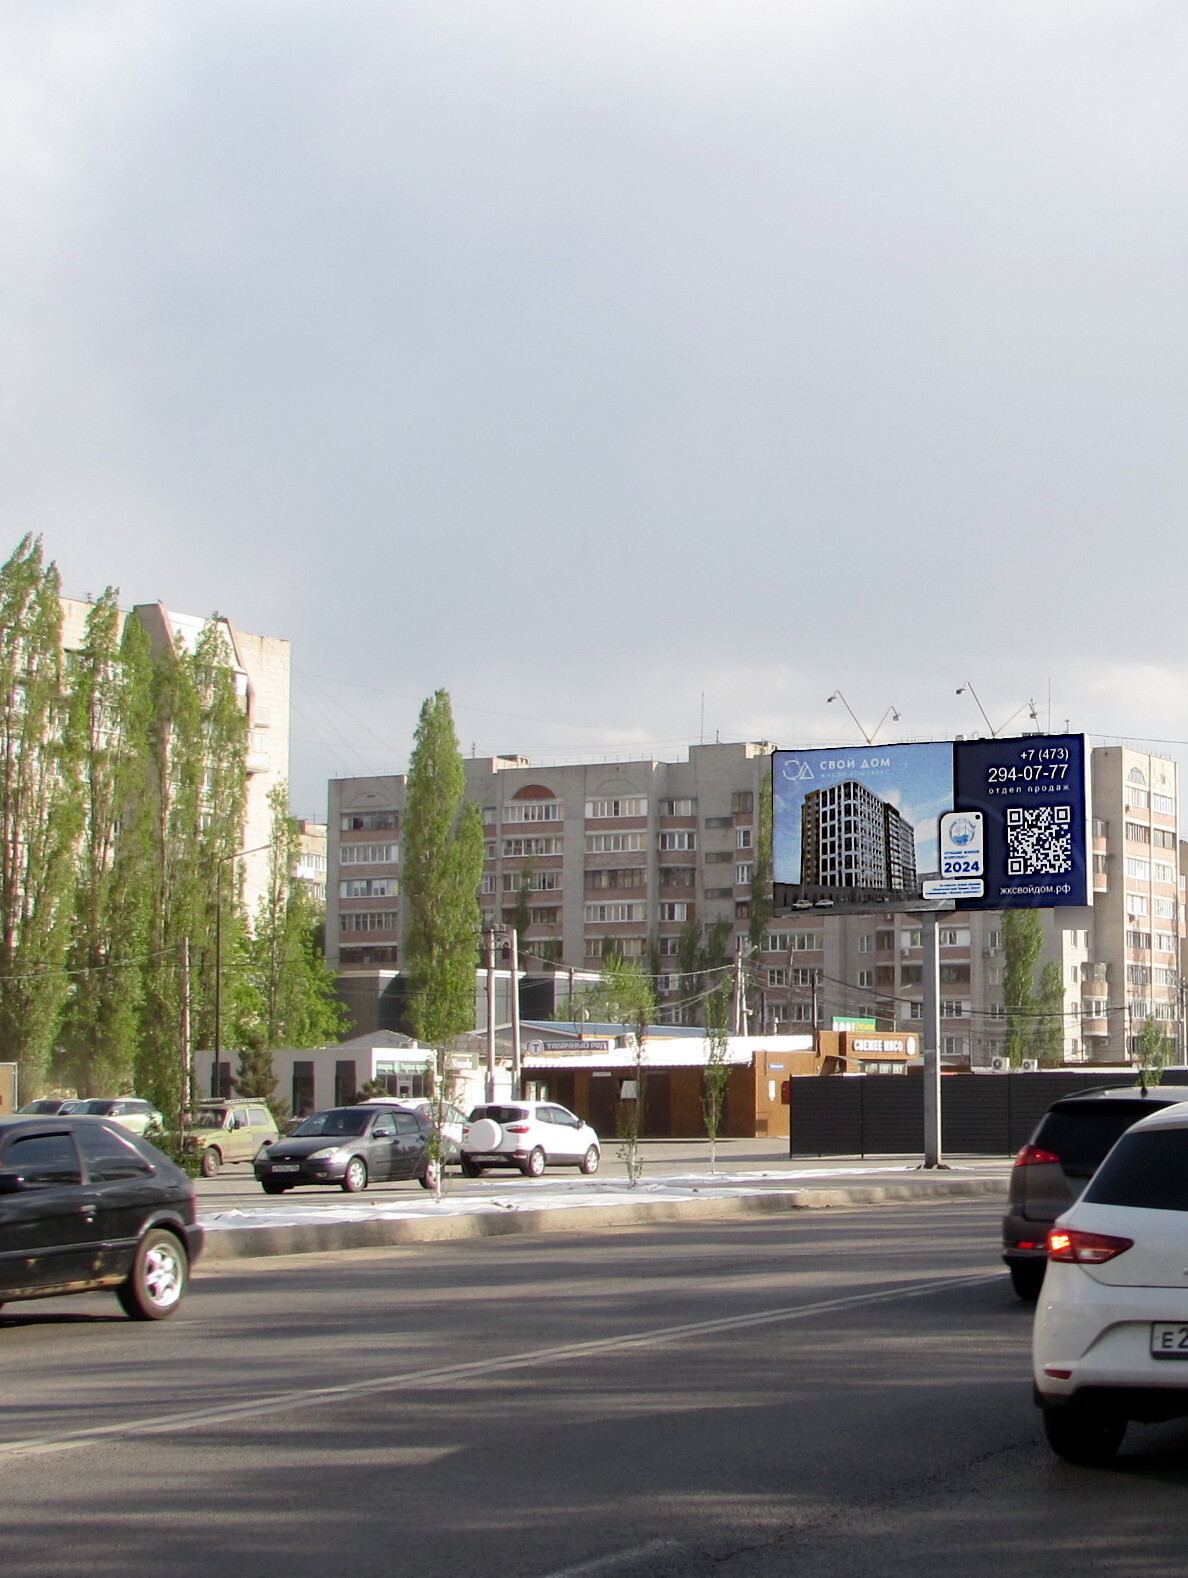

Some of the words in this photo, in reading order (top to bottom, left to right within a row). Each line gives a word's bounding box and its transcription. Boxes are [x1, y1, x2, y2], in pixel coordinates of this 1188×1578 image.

[1020, 749, 1035, 761] +7
[1038, 747, 1069, 762] (473)
[820, 757, 856, 770] СВОЙ
[861, 758, 890, 769] ДОМ
[988, 764, 1069, 782] 294-07-77
[988, 786, 1022, 795] отдел
[1027, 783, 1070, 793] продаж
[944, 860, 980, 873] 2024
[1000, 883, 1071, 895] жксвойдом.рф
[853, 1039, 883, 1051] СВЕЖЕЕ
[883, 1040, 903, 1052] МЯСО
